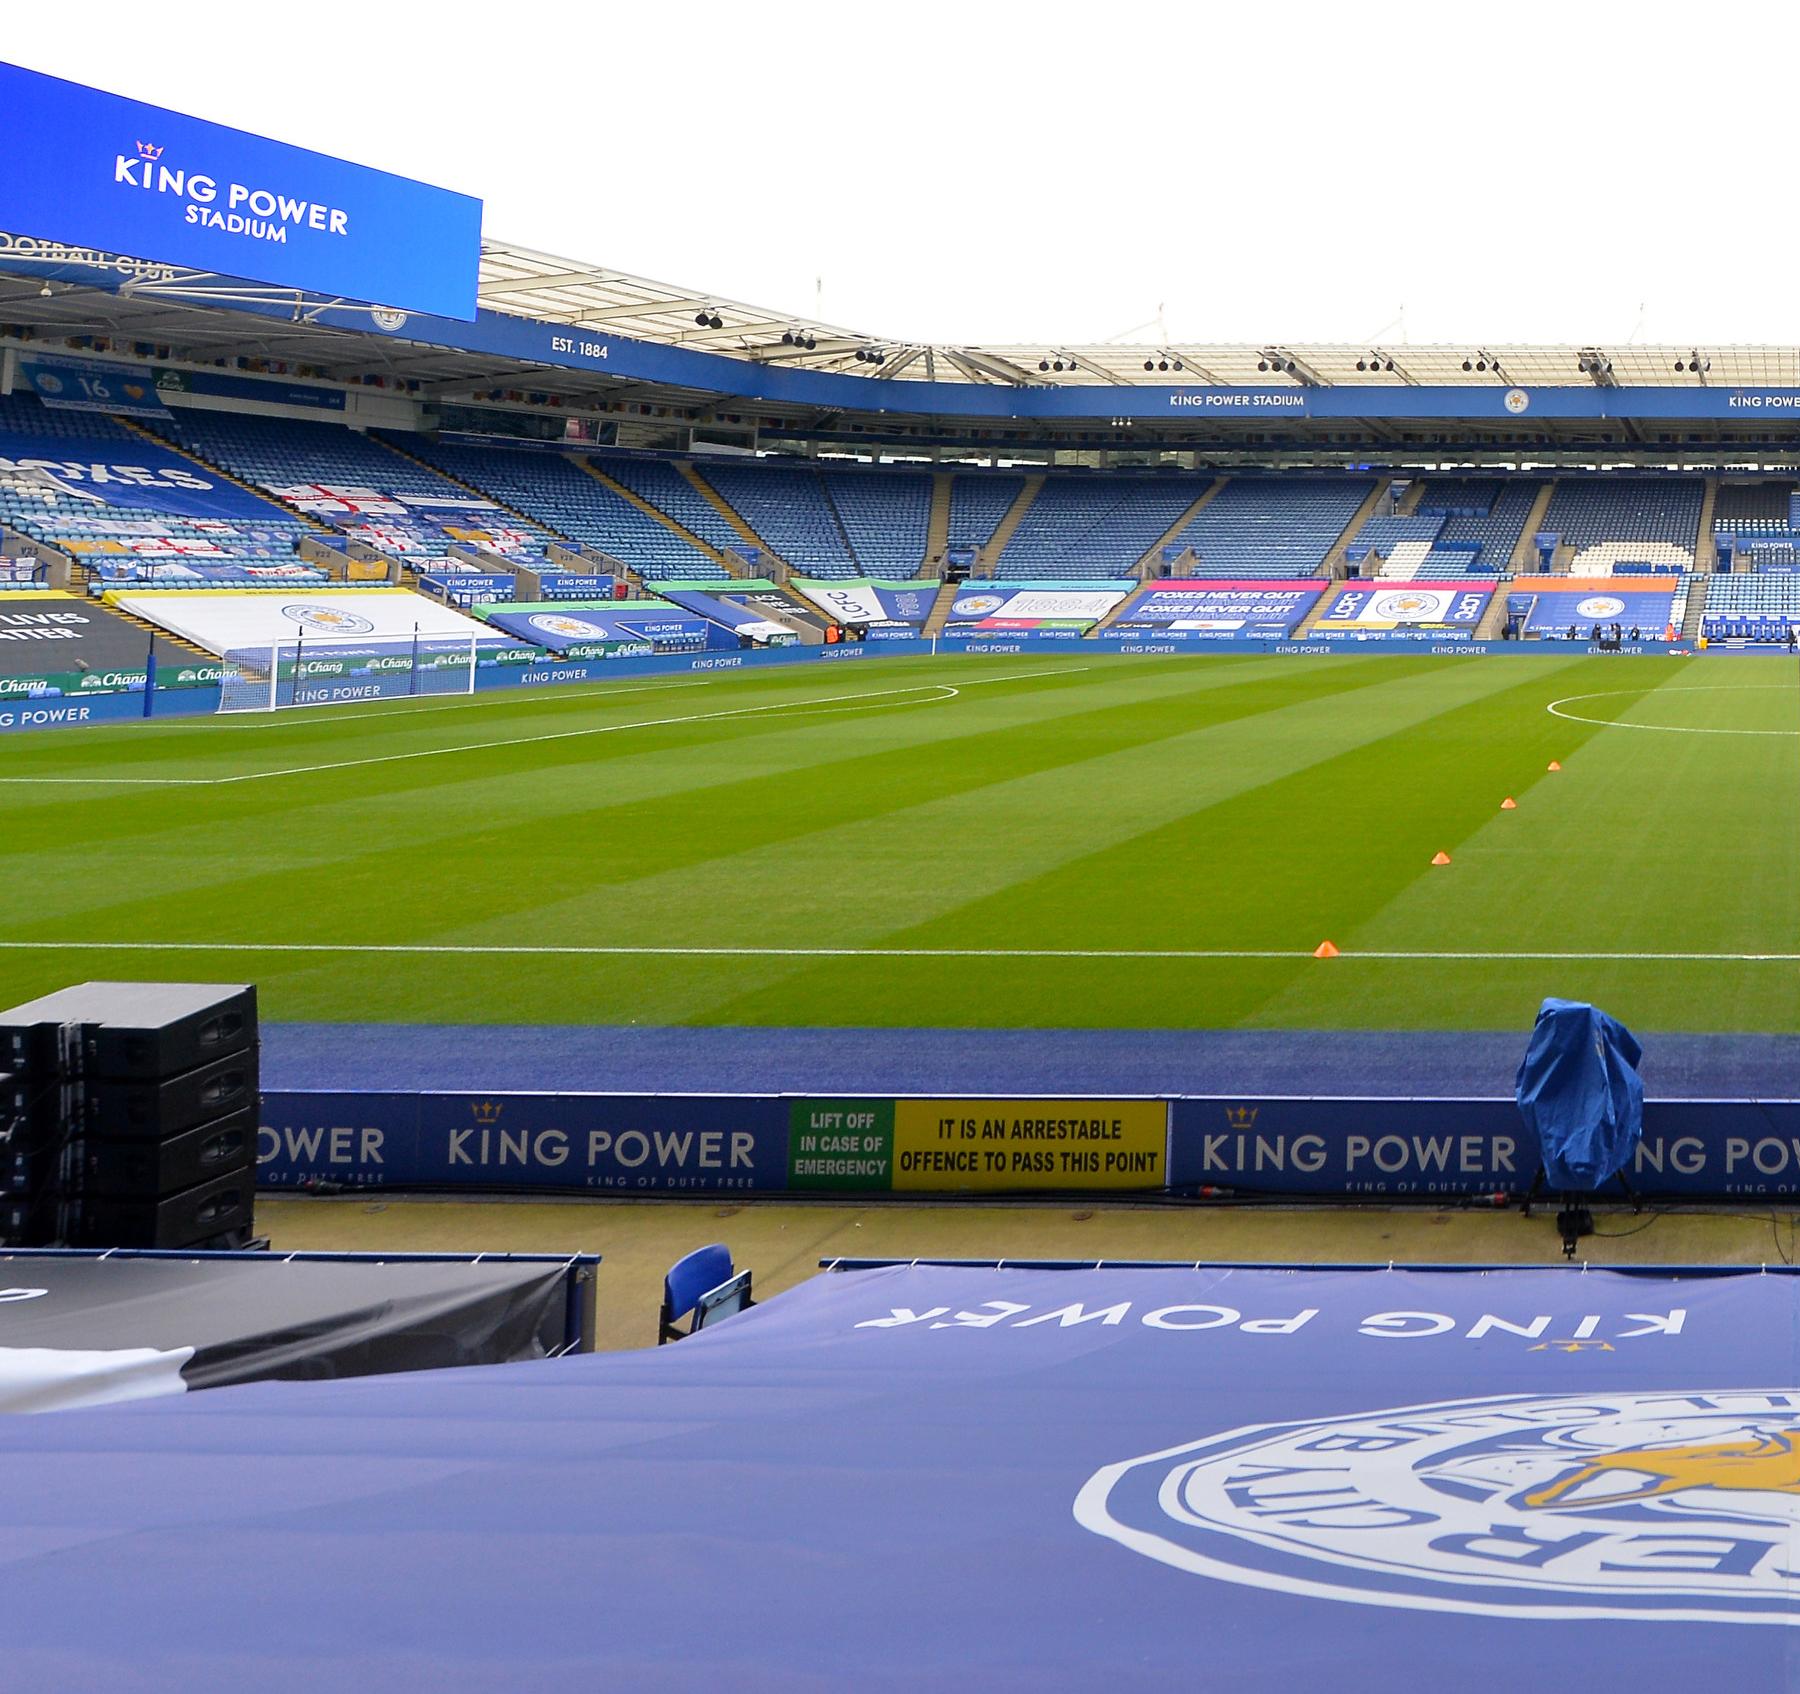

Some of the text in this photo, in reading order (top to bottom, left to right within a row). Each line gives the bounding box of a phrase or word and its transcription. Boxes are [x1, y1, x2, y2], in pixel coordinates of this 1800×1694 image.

[115, 155, 348, 236] KING POWER
[186, 204, 287, 244] STADIUM
[552, 337, 608, 360] EST. 1884
[78, 377, 111, 399] 16
[1170, 395, 1305, 406] KING POWER STADIUM
[1729, 396, 1761, 407] KING
[827, 591, 871, 618] LCFC
[1329, 593, 1364, 619] LCFC
[1454, 593, 1484, 620] LCFC
[509, 651, 535, 662] Chang
[580, 646, 604, 657] Chang
[1276, 646, 1330, 654] KING POWER
[1431, 646, 1453, 654] KING
[308, 662, 343, 673] Chang
[692, 658, 742, 669] KING POWER
[521, 669, 587, 683] KING POWER
[0, 680, 47, 693] Chang
[22, 708, 90, 724] POWER
[810, 1113, 875, 1129] LIFT OFF
[939, 1119, 1122, 1139] IT IS AN ARRESTABLE
[257, 1127, 384, 1163] OWER
[449, 1128, 754, 1168] KING POWER
[800, 1136, 883, 1152] IN CASE OF
[1203, 1134, 1517, 1173] KING POWER
[900, 1151, 1158, 1172] OFFENCE TO PASS THIS POINT
[1635, 1137, 1706, 1174] NG
[795, 1159, 887, 1175] EMERGENCY
[587, 1176, 754, 1188] KING OF DUTY FREE
[853, 1300, 1688, 1341] KING POWER
[1294, 1405, 1622, 1453] CLUB
[1222, 1464, 1441, 1529] CITY
